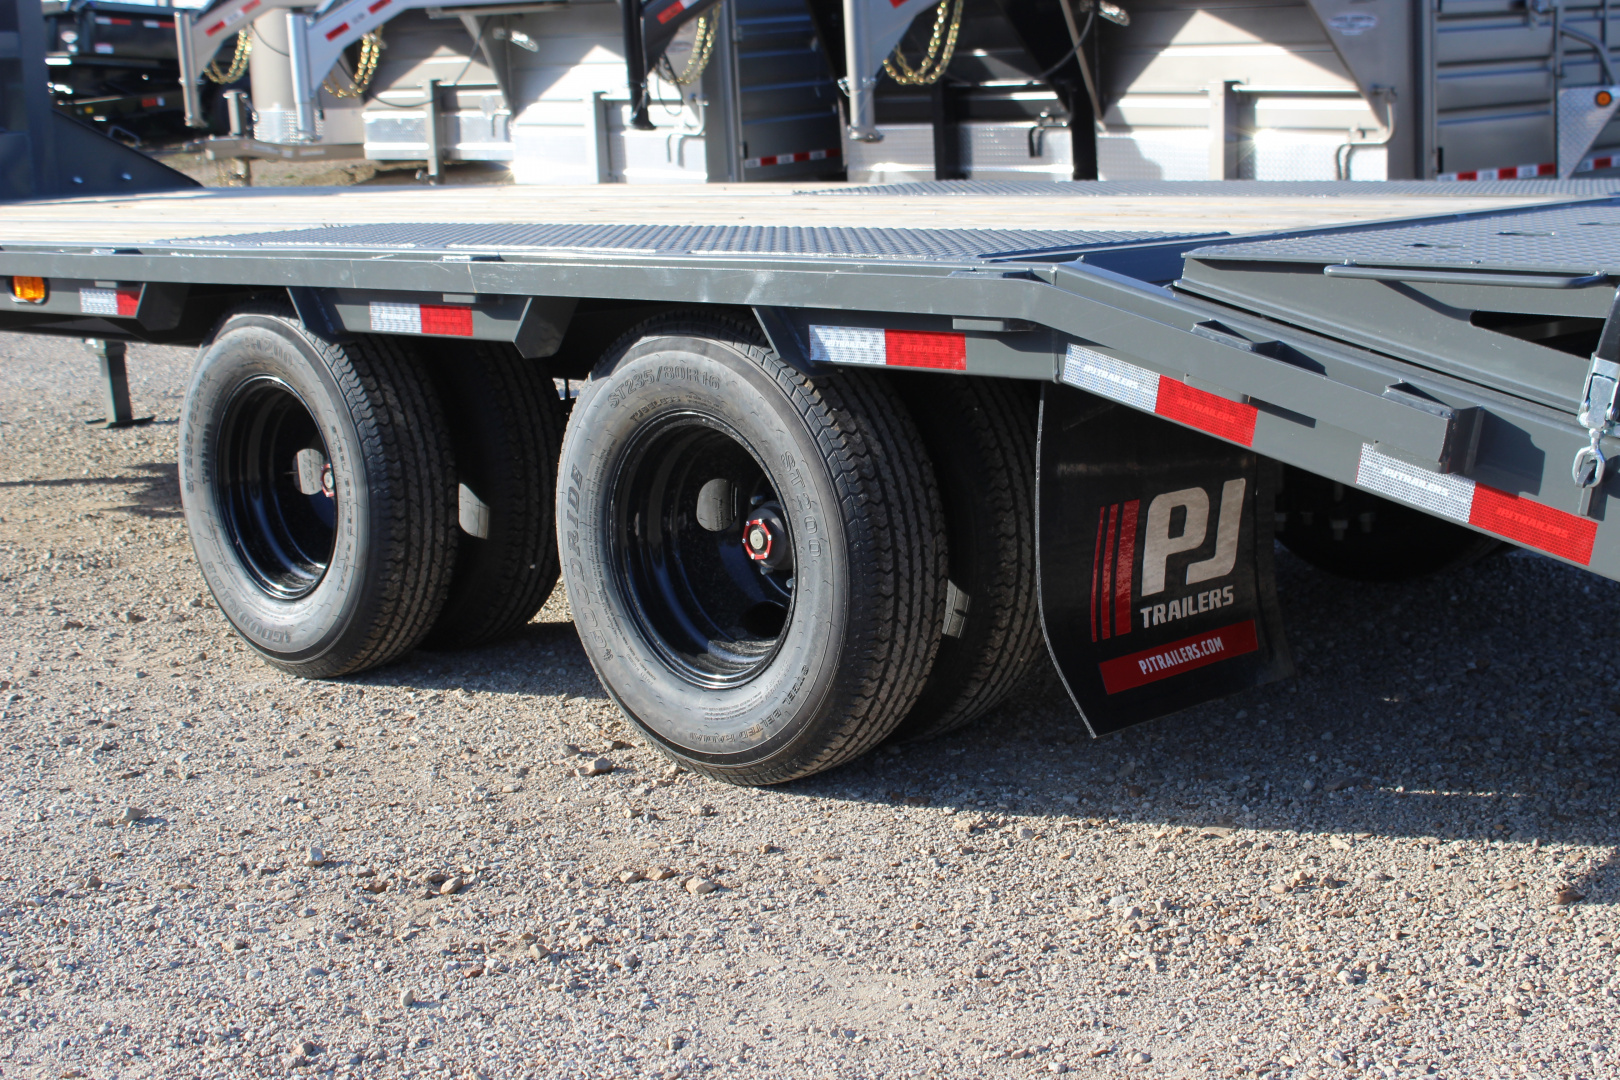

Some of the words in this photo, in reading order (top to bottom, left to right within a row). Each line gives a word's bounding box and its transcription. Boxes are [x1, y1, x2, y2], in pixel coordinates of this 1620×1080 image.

[607, 366, 721, 408] ST235/80R16
[779, 449, 822, 557] ST200
[1141, 478, 1246, 597] PJ
[567, 461, 608, 652] GOODRIDE
[1140, 585, 1234, 628] TRAILERS
[1138, 636, 1224, 675] PJTRAILERS.COM
